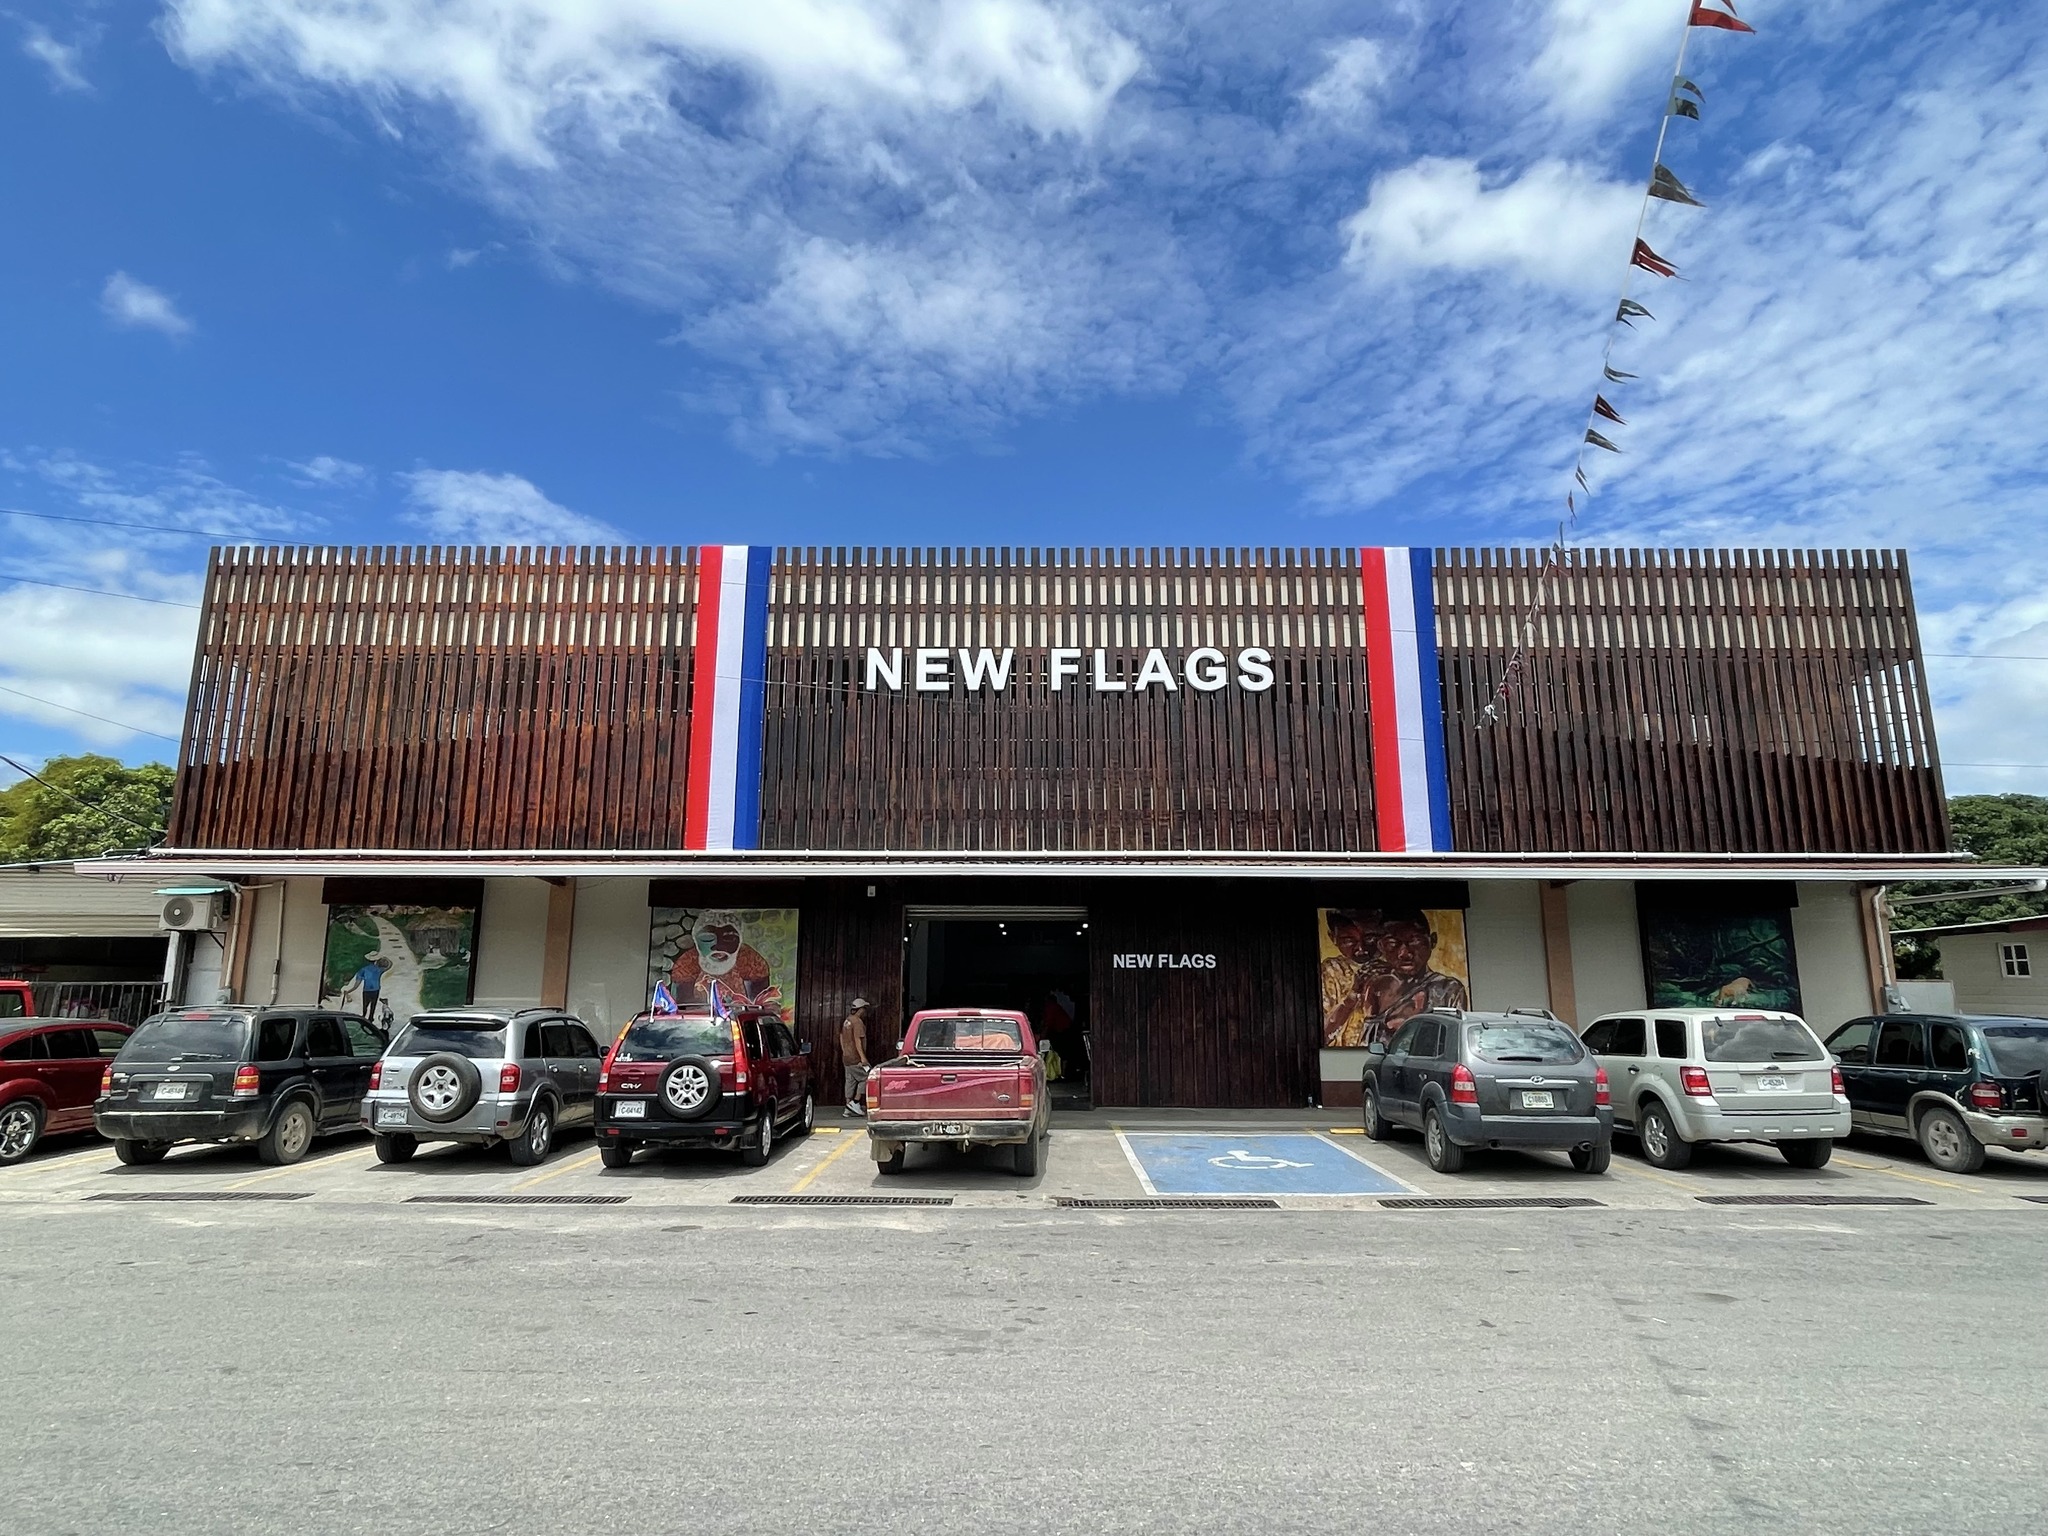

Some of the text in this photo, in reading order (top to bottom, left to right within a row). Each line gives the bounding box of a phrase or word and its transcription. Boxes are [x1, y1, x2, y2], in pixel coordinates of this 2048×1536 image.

[866, 647, 1275, 692] NEW FLAGS
[1113, 953, 1217, 969] NEW FLAGS
